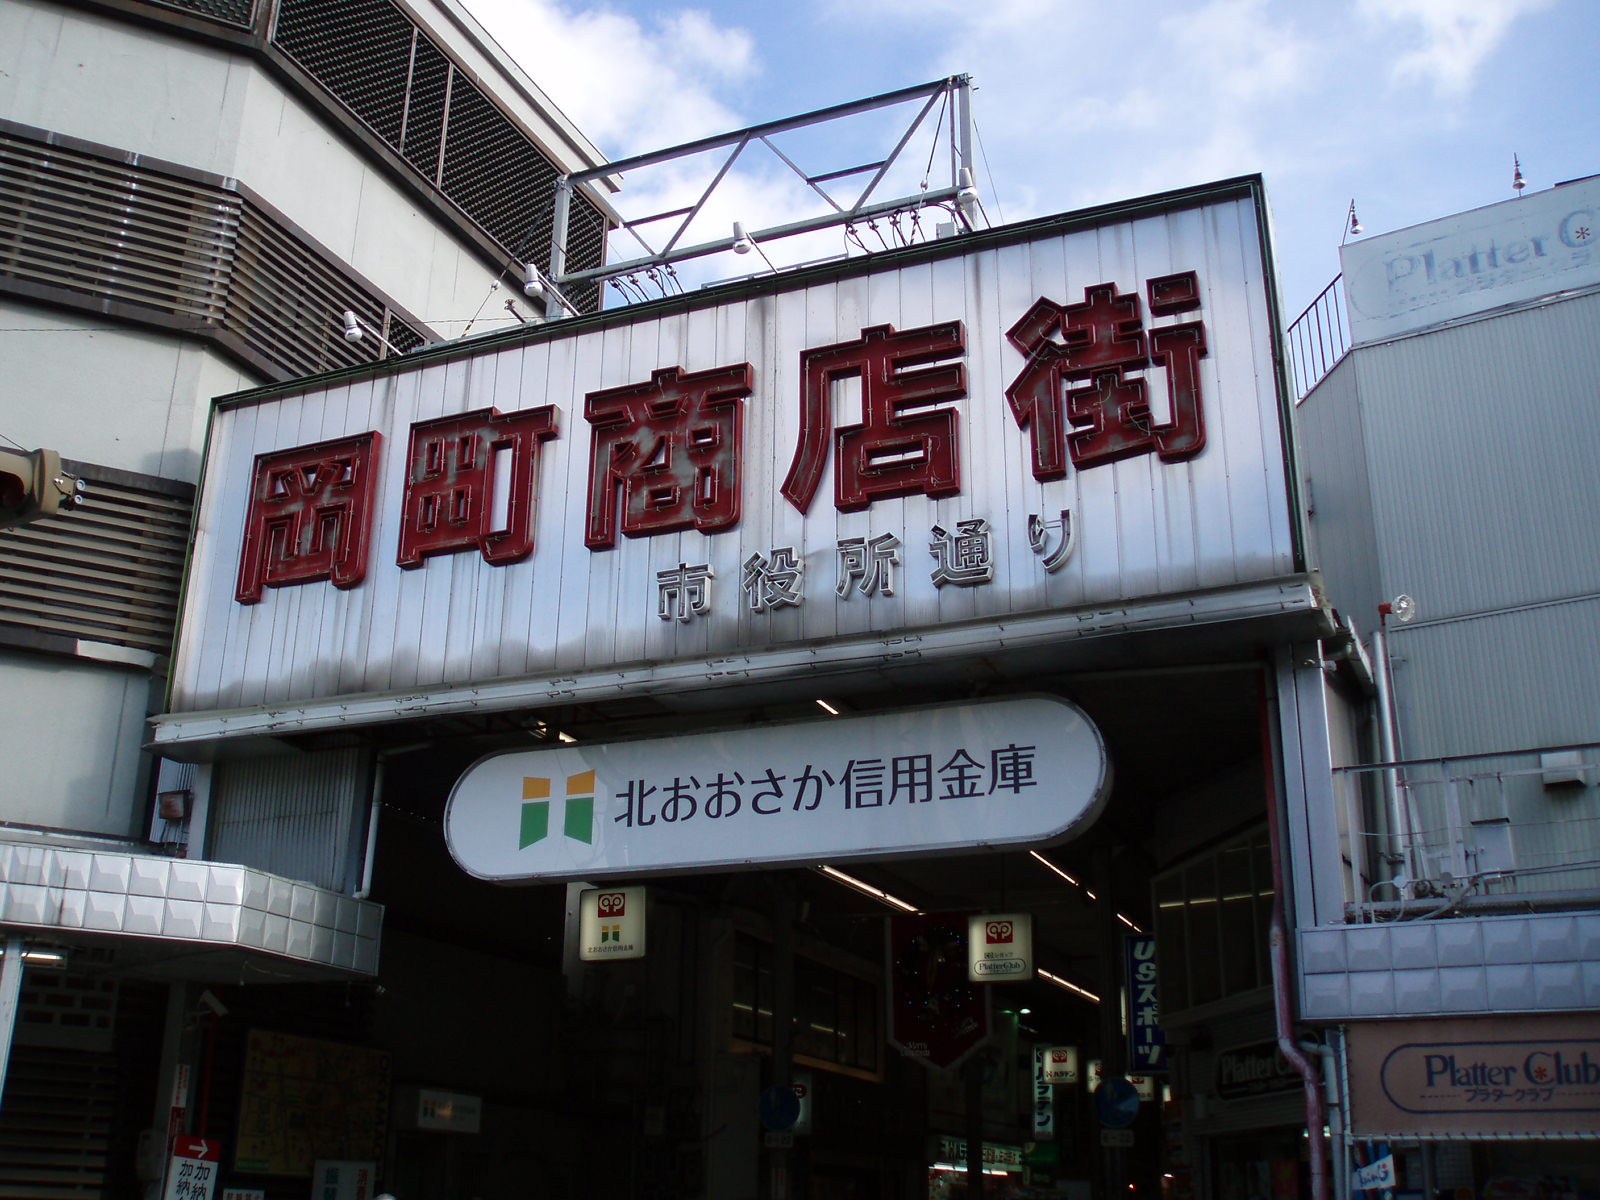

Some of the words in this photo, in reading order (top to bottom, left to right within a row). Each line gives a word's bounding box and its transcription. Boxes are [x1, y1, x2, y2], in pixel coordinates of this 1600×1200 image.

[1382, 235, 1550, 296] Platter
[235, 269, 1208, 604] 岡町商店街
[656, 508, 1076, 623] 市役所通り
[614, 743, 1038, 828] 北おおさか信用金庫
[1134, 940, 1161, 1065] USスポーツ
[1424, 1054, 1517, 1087] Platter
[1523, 1050, 1600, 1085] Club
[1464, 1088, 1556, 1102] プラタークラブ
